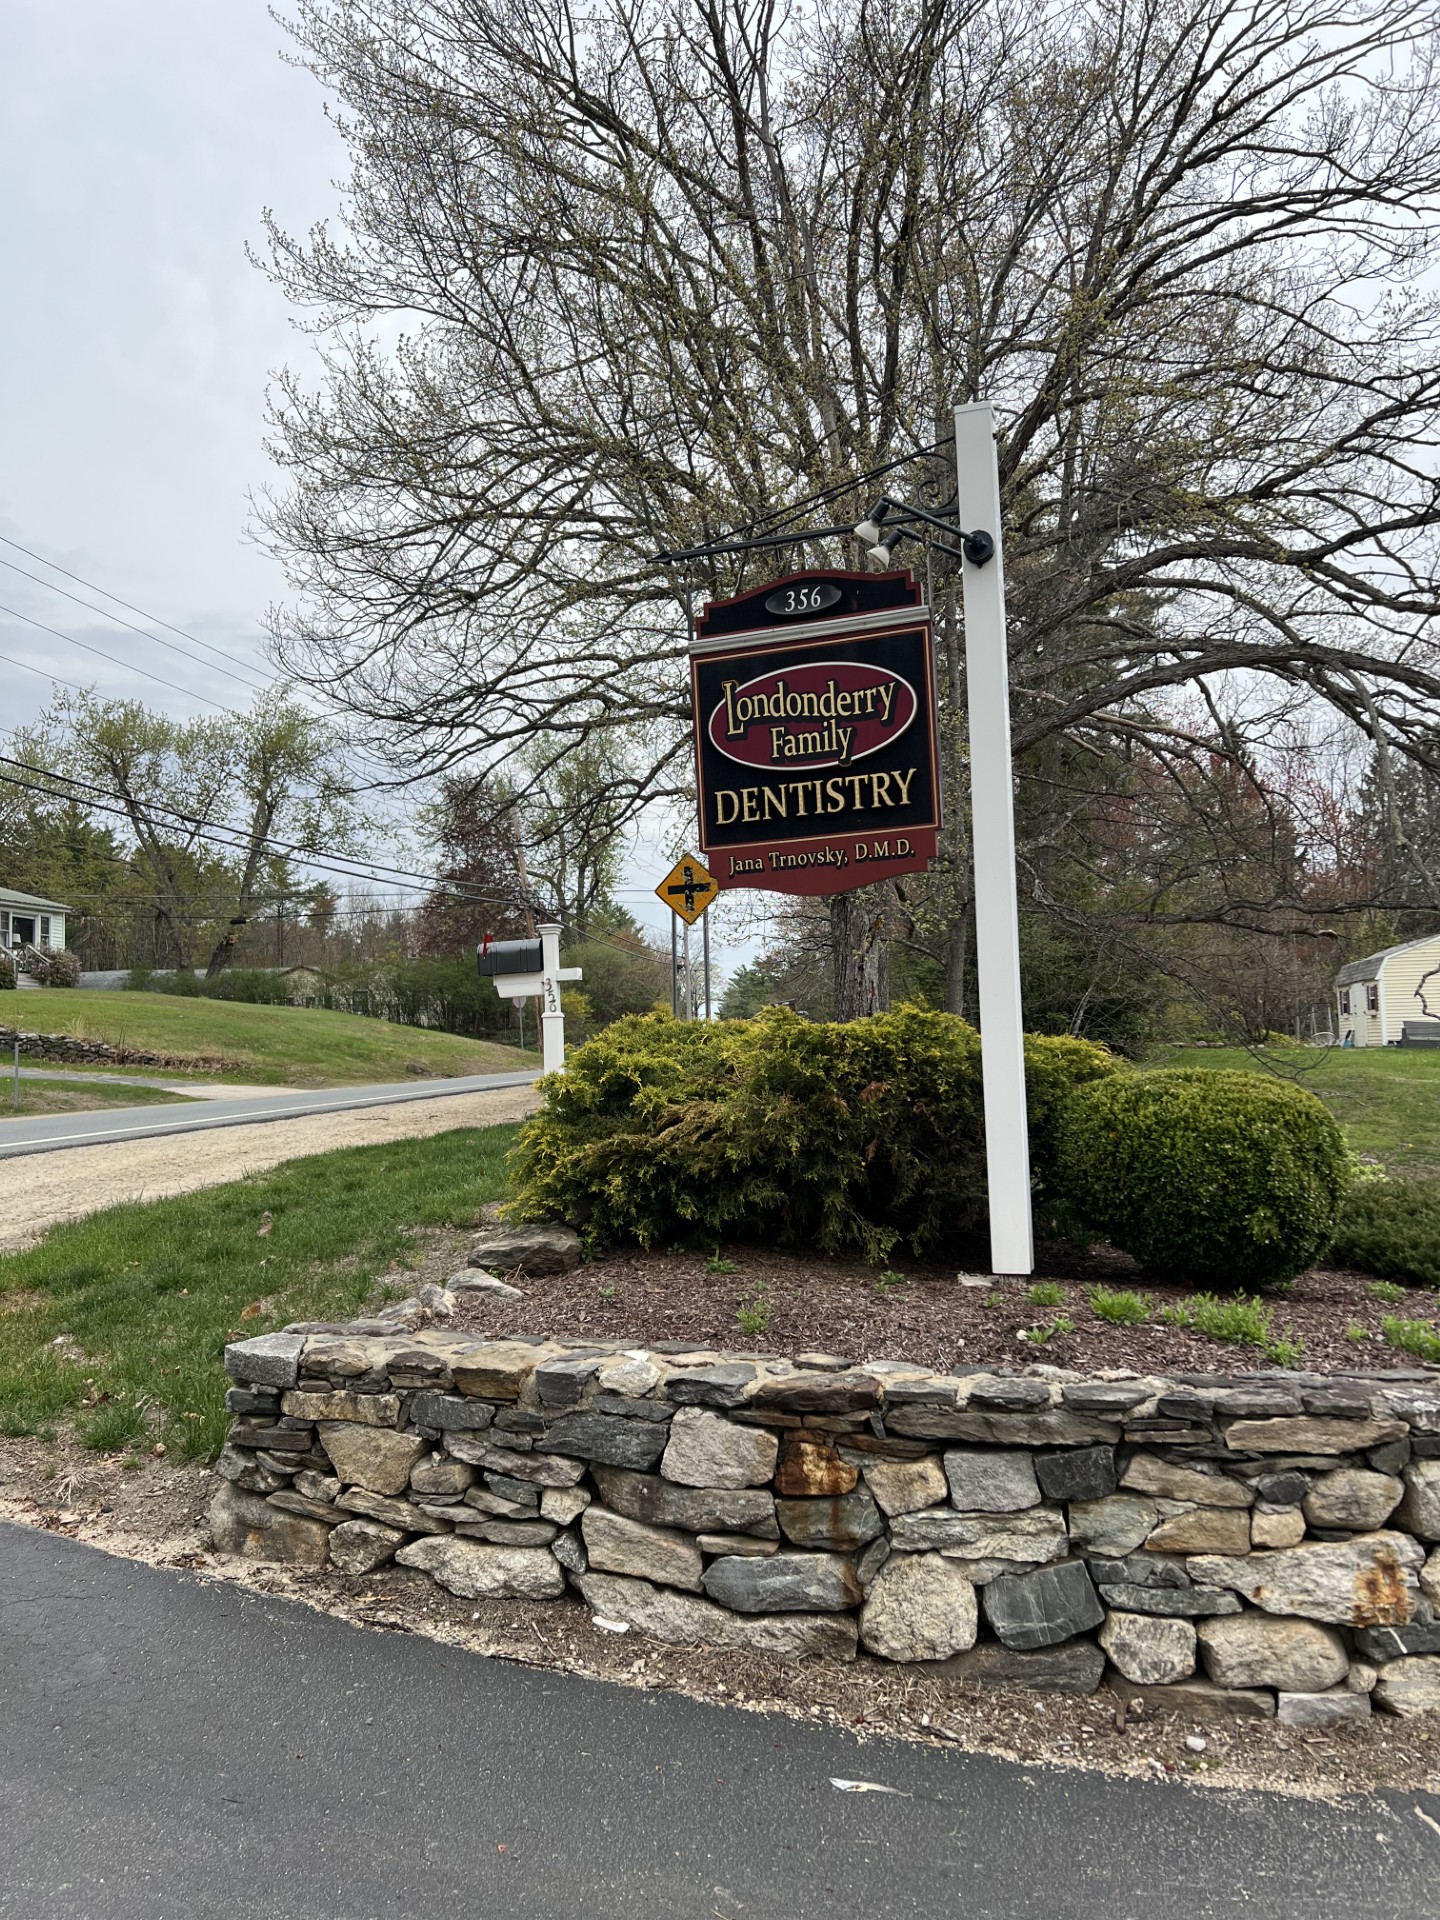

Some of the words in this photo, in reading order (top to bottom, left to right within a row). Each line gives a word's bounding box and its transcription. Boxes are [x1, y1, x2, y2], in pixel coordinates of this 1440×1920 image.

[785, 586, 821, 612] 356
[722, 681, 896, 735] Londonderry
[770, 720, 852, 760] Family
[715, 768, 917, 825] DENTISTRY
[729, 856, 763, 875] Jana
[768, 848, 848, 870] Trnovsky,
[854, 839, 915, 861] D.M.D.
[545, 977, 557, 1013] 356
